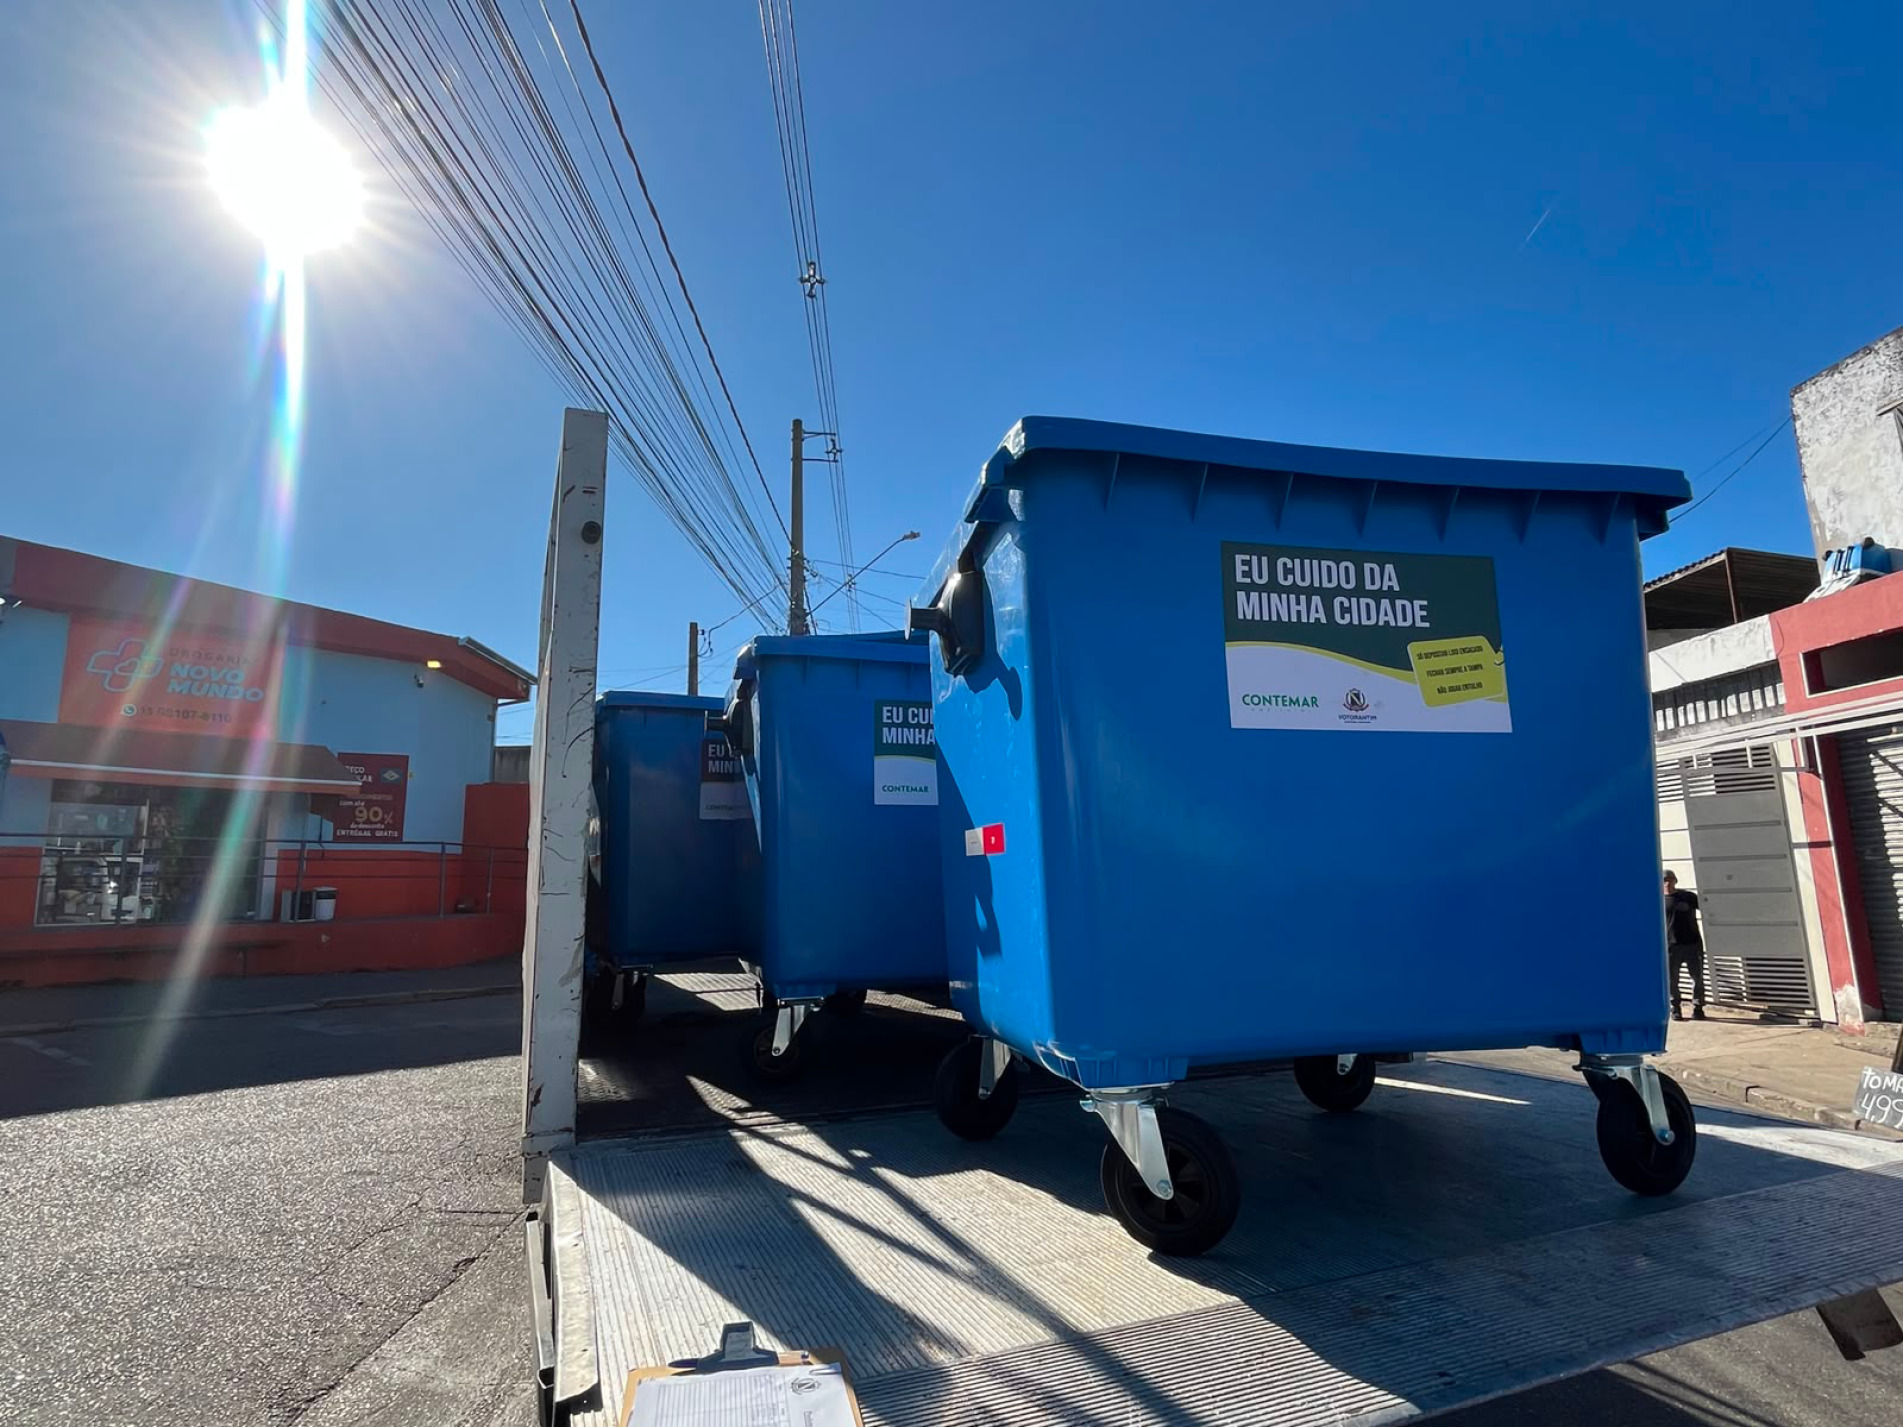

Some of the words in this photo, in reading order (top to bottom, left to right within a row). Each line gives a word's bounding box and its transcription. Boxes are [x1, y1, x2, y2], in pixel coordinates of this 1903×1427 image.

[1235, 553, 1269, 585] EU
[1276, 557, 1357, 590] CUIDO
[1363, 562, 1400, 591] DA
[1236, 590, 1327, 624] MINHA
[1333, 596, 1431, 628] CIDADE
[170, 663, 245, 684] NOVO
[1445, 666, 1464, 675] SEMPRE
[167, 678, 264, 702] MUNDO
[1242, 693, 1319, 708] CONTEMAR
[882, 706, 904, 724] EU
[908, 707, 934, 724] CUI
[882, 727, 936, 745] MINHA
[708, 744, 724, 757] EU
[882, 784, 930, 793] CONTEMAR
